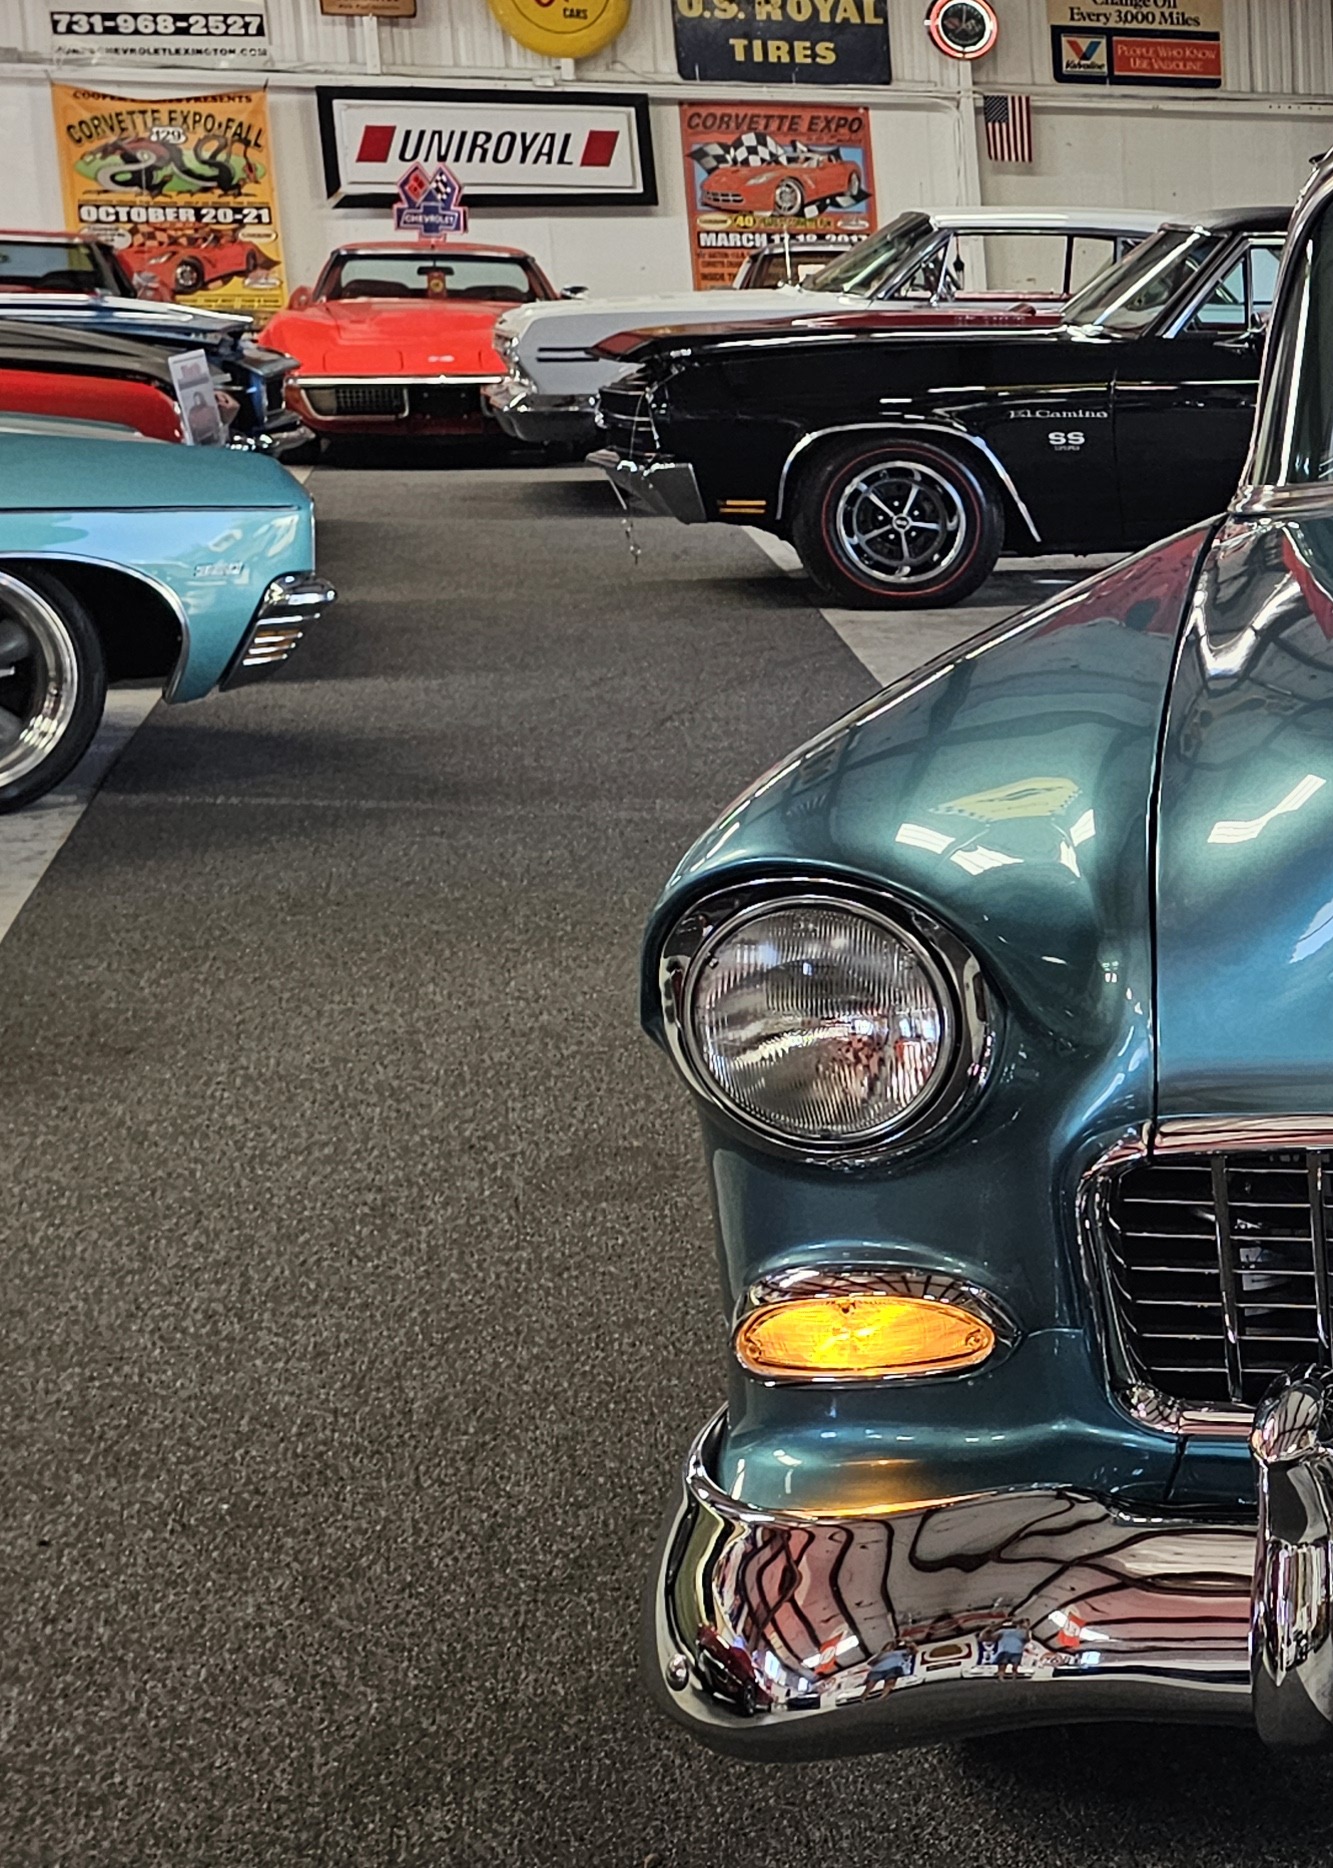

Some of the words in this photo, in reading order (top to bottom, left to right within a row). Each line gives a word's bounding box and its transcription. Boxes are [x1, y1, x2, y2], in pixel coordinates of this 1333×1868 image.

[755, 0, 884, 24] ROYAL
[1069, 7, 1112, 25] Every
[1158, 11, 1200, 27] Miles
[52, 14, 261, 35] 731-968-2527
[729, 38, 837, 65] TIRES
[66, 109, 161, 144] CORVETTE
[687, 112, 801, 132] CORVETTE
[807, 115, 863, 134] EXPO
[398, 129, 573, 165] UNIROYAL
[79, 206, 196, 222] OCTOBER
[201, 207, 270, 224] 20-21
[404, 213, 455, 225] CHEVROLET
[699, 232, 768, 248] MARCH
[1035, 409, 1108, 418] Camino
[1048, 431, 1085, 445] SS
